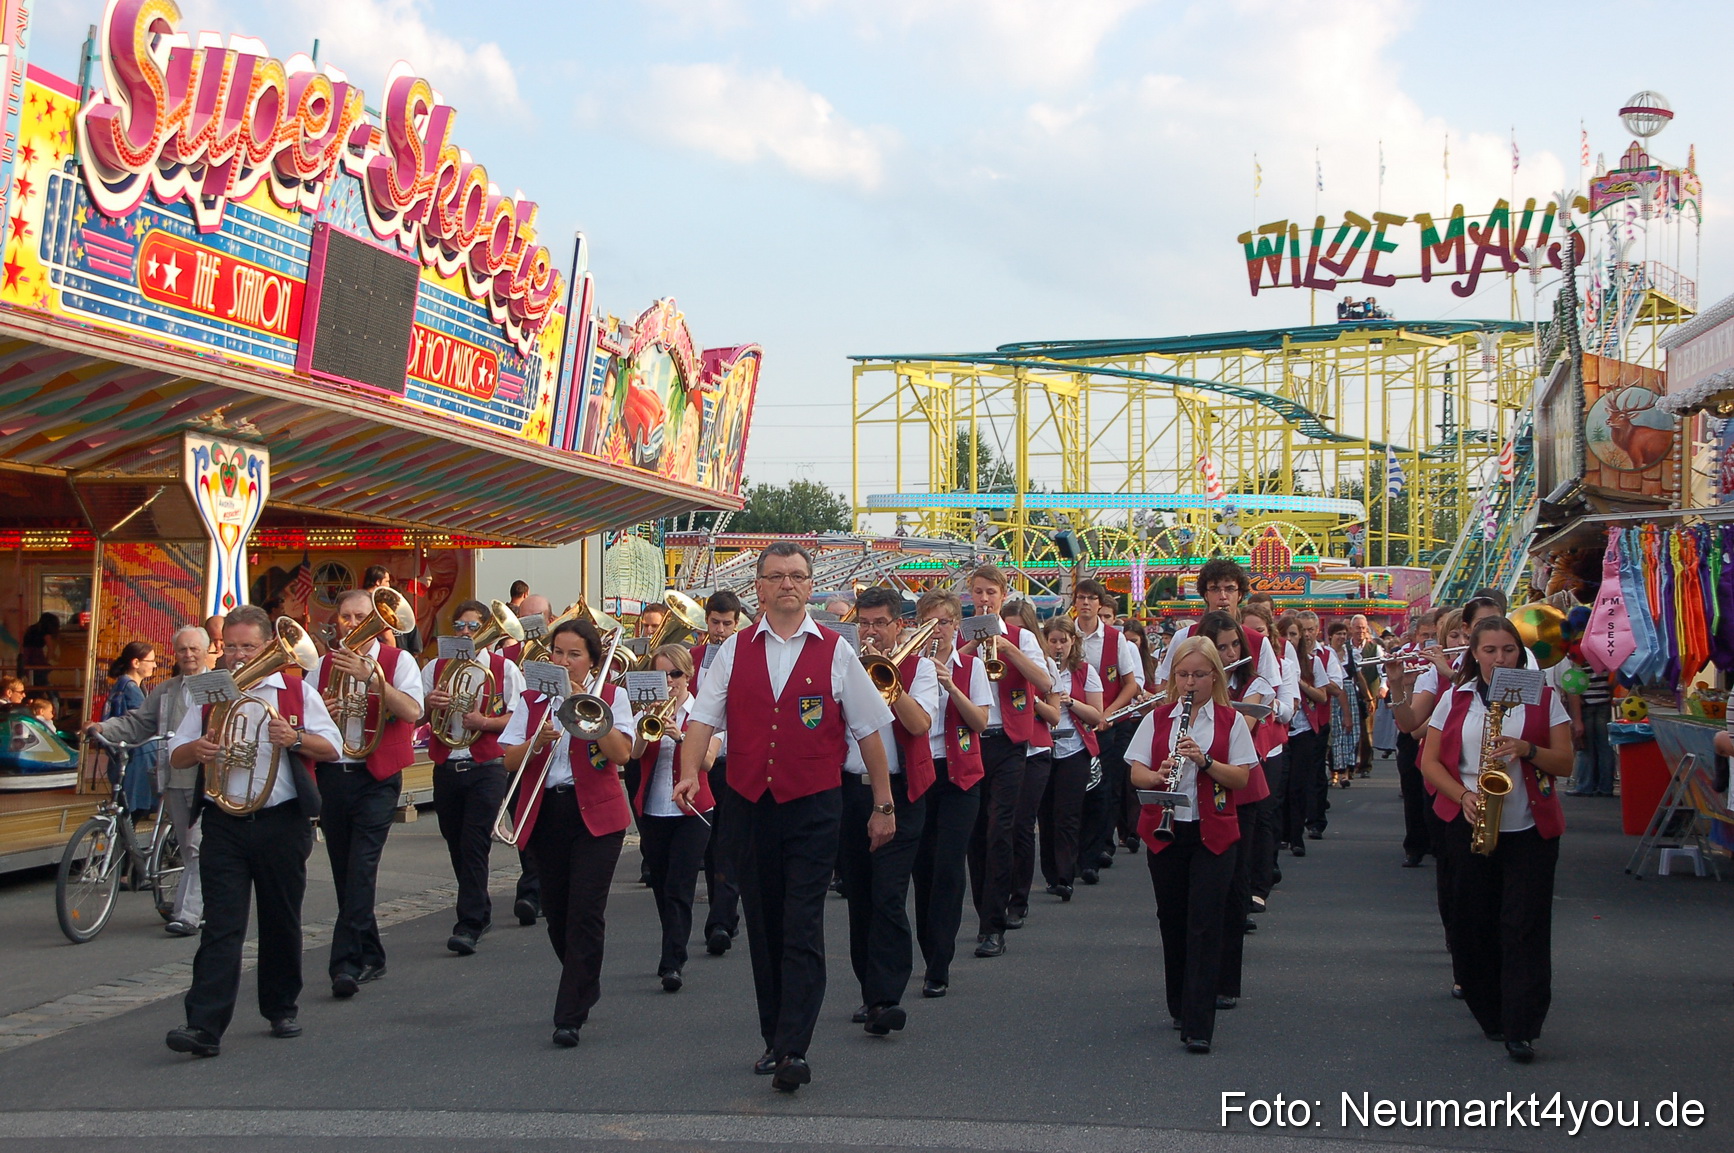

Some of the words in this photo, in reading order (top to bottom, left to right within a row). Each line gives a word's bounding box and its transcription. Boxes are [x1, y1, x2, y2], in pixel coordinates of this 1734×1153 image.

[1237, 210, 1409, 297] WILDE
[1413, 194, 1589, 298] MAUS
[191, 250, 222, 313] THE
[226, 264, 293, 334] STATION
[422, 331, 452, 384] HOT
[447, 341, 481, 394] MUSIC
[1247, 575, 1306, 595] Kasse
[1607, 608, 1615, 616] 2
[1607, 621, 1615, 657] SEXY
